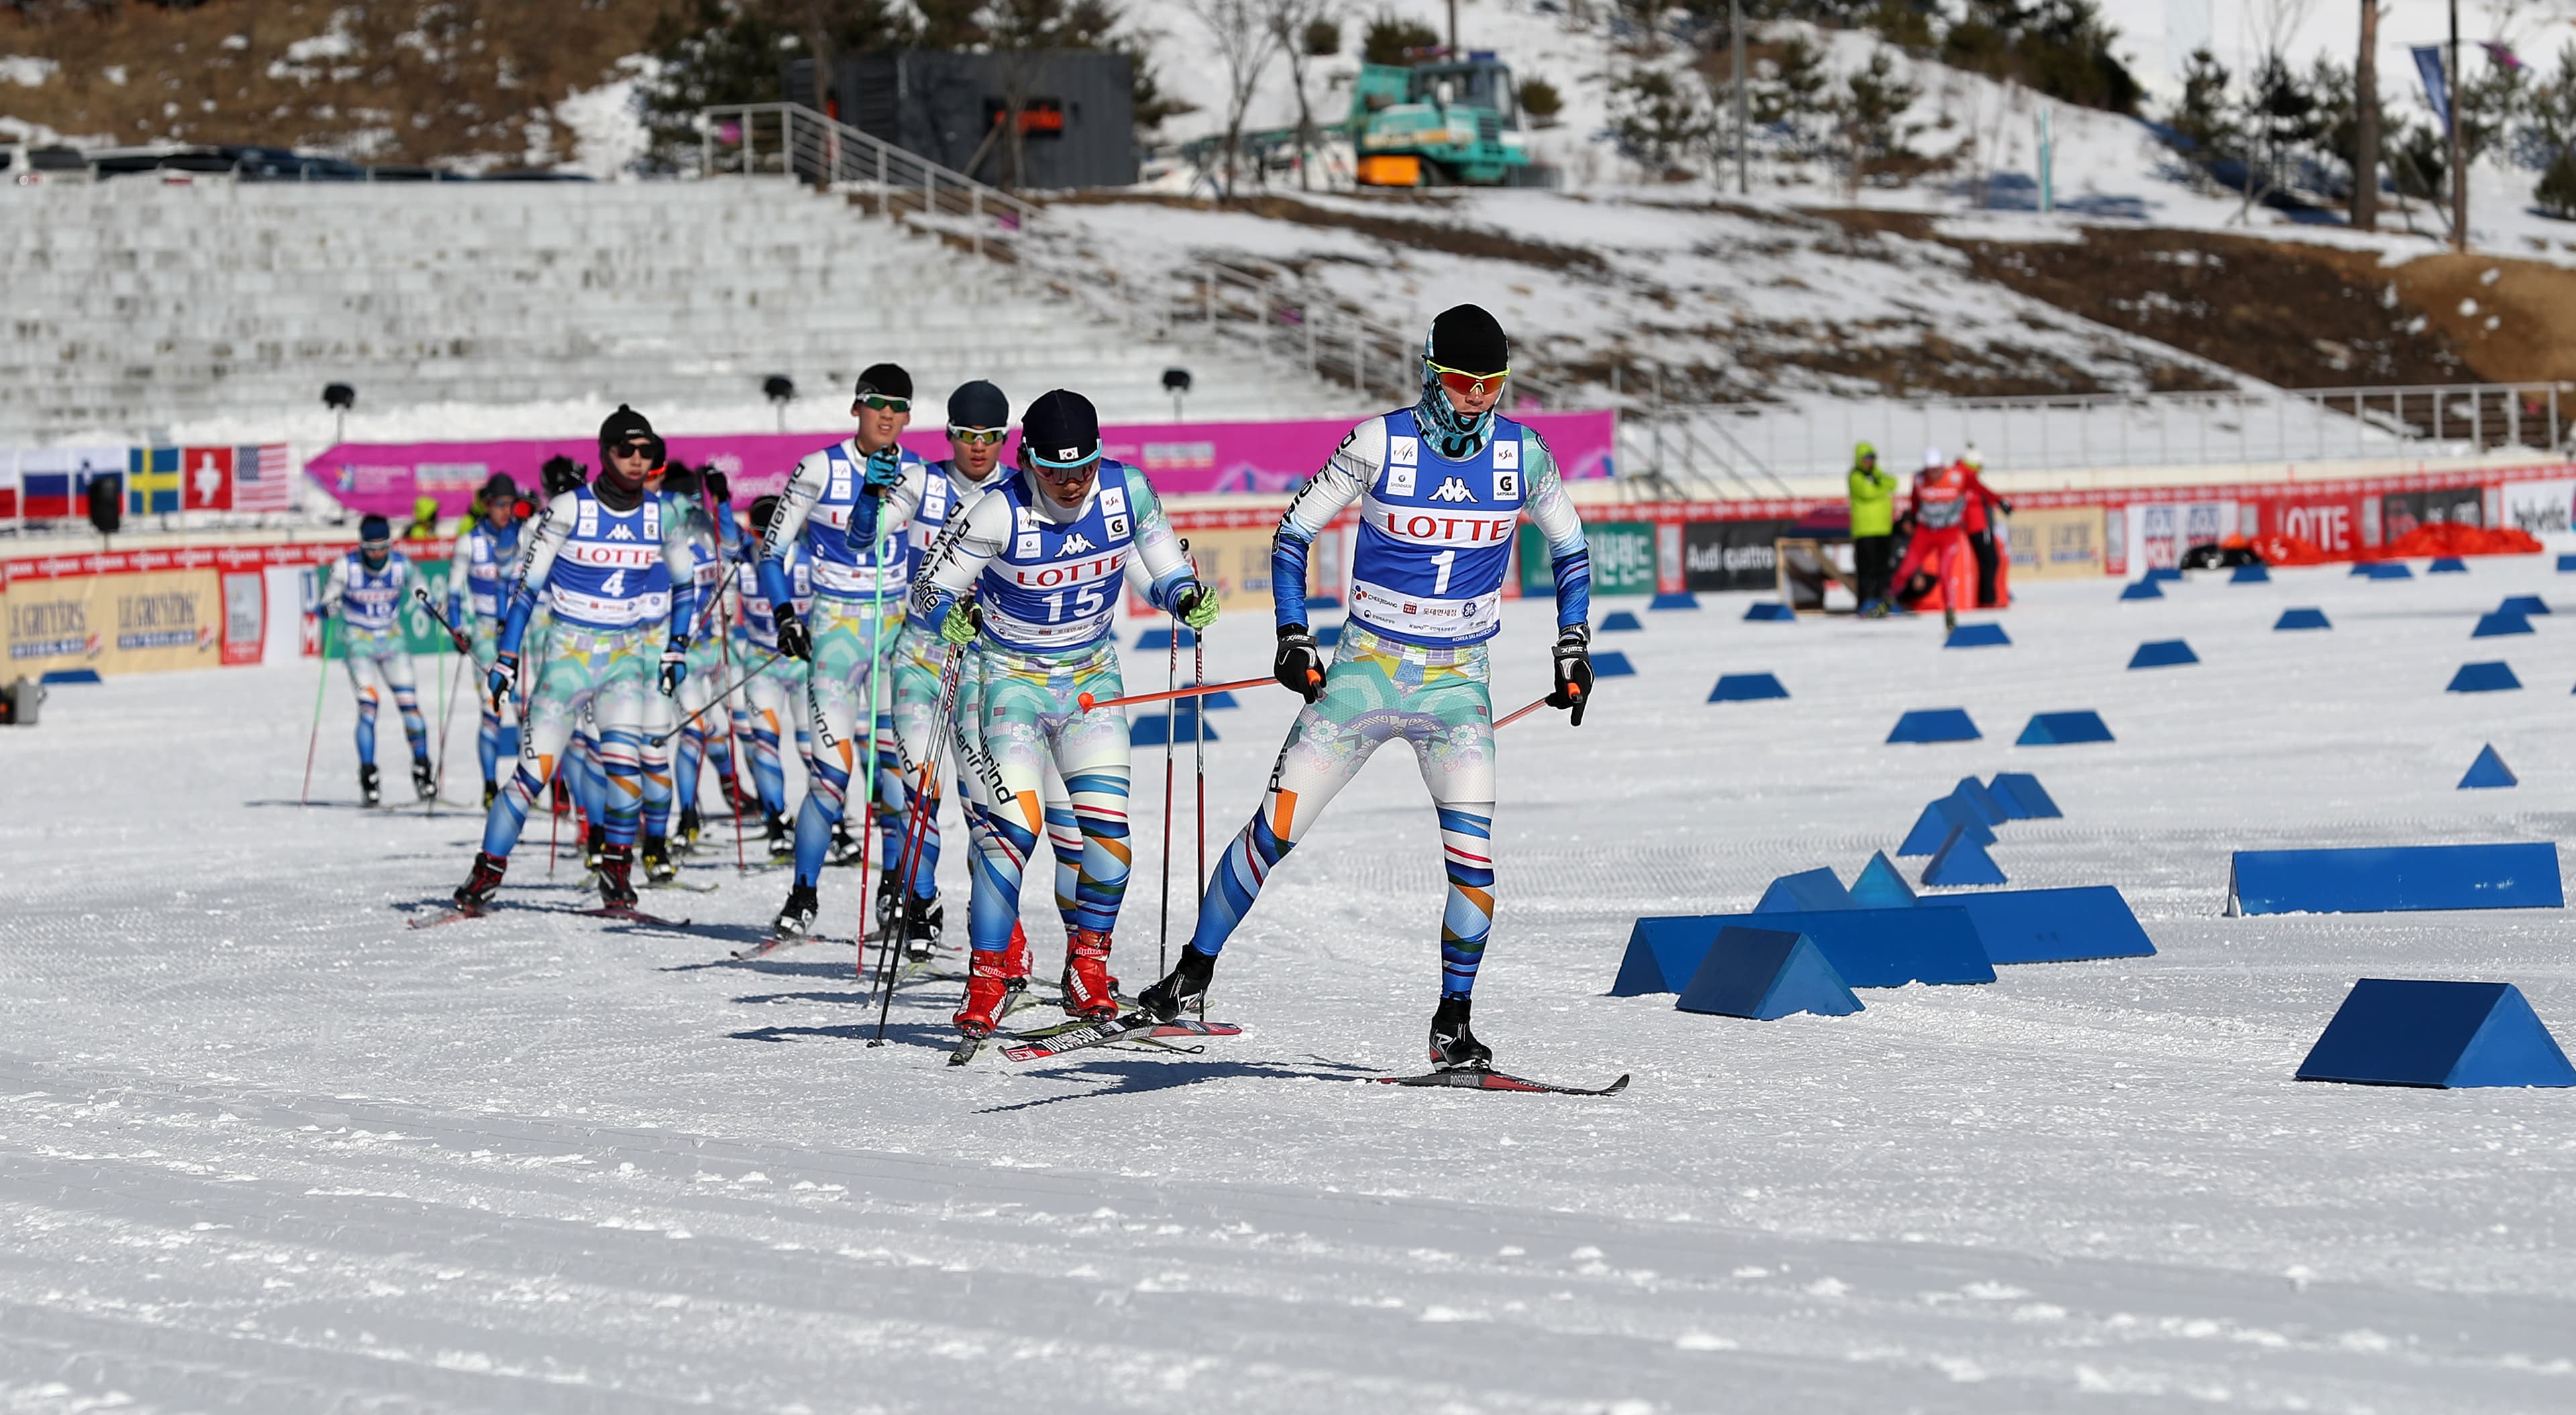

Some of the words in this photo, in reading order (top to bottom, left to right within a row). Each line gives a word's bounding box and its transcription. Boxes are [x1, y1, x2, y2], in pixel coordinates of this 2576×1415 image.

[1498, 449, 1513, 461] KSA
[1387, 512, 1512, 541] LOTTE
[576, 547, 658, 565] LOTTE
[1016, 550, 1128, 587] LOTTE
[600, 569, 625, 598] 4
[1430, 549, 1454, 595] 1
[1041, 580, 1106, 623] 15
[1075, 947, 1104, 956] alpina
[1450, 1074, 1480, 1086] ROSSIGNOL
